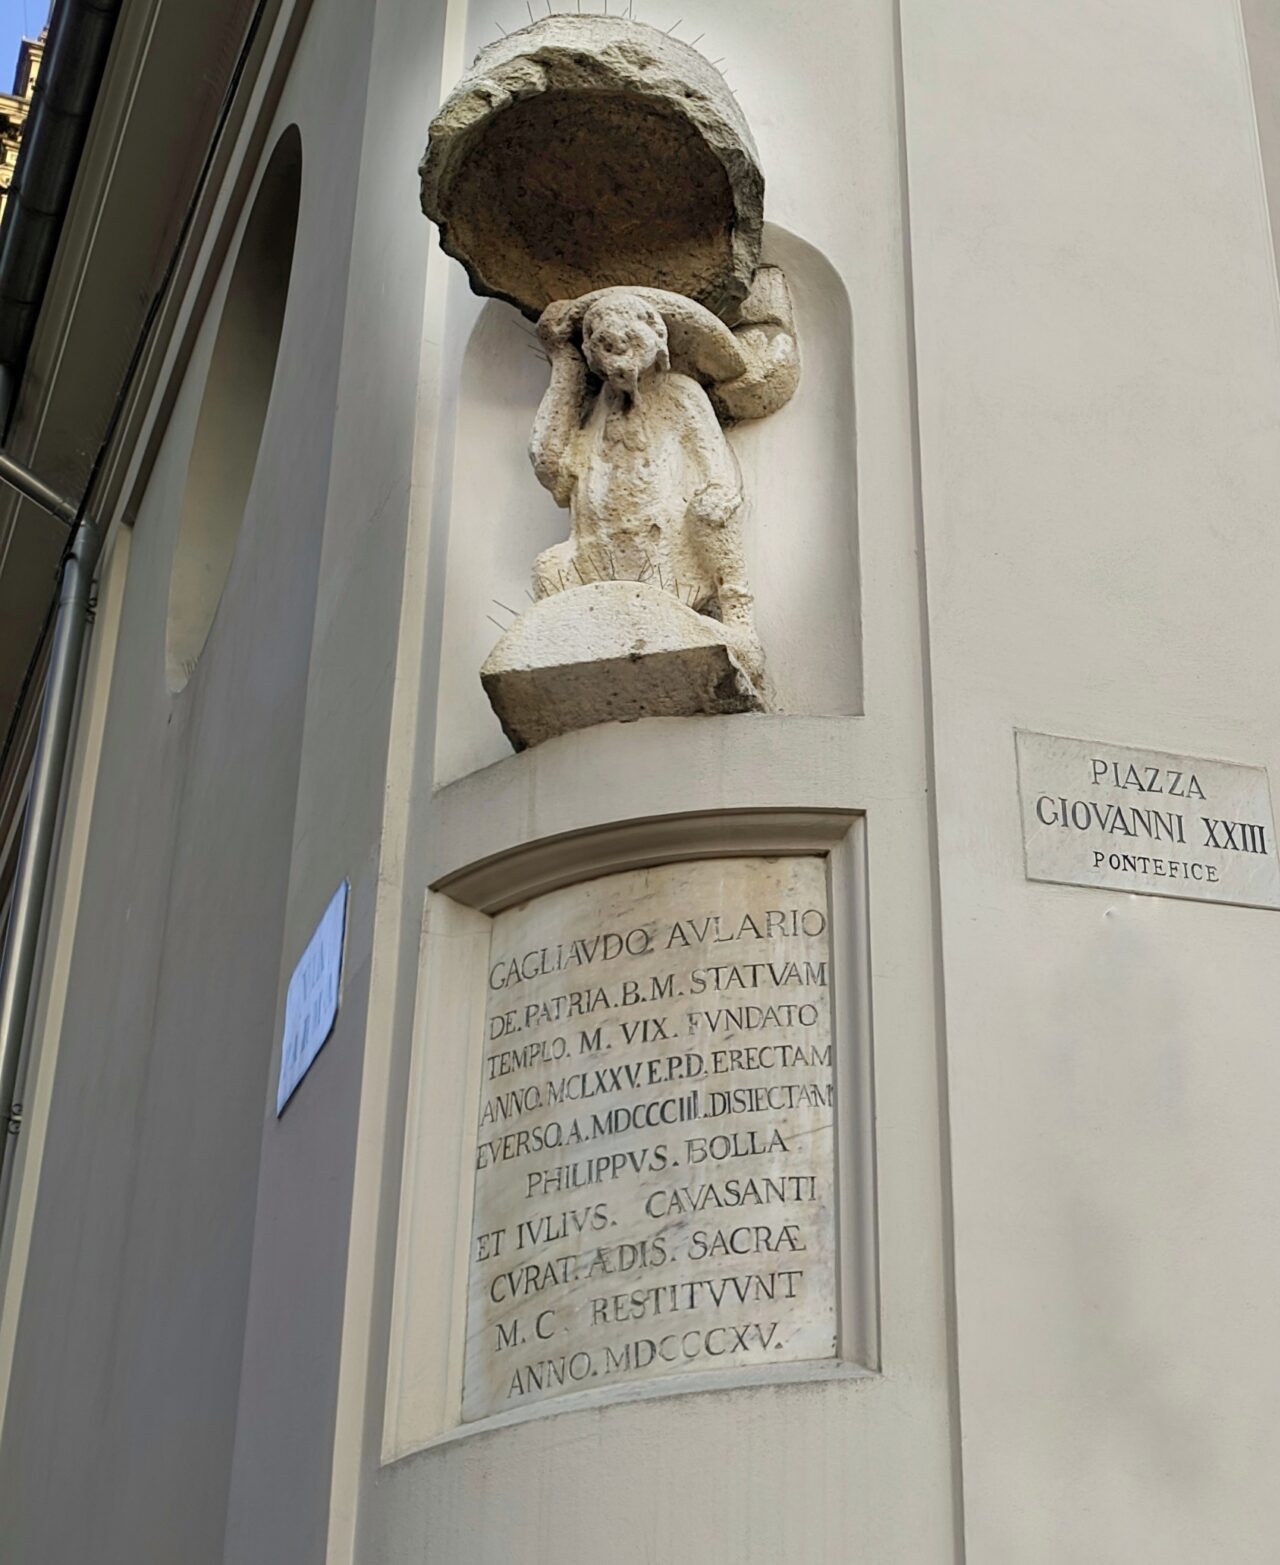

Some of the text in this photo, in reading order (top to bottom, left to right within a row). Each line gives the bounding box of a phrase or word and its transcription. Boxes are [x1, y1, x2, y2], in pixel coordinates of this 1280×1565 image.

[1091, 758, 1206, 800] PIAZZA
[1036, 795, 1268, 854] GIOVANNI XXIII
[1092, 851, 1220, 882] PONTEFICE
[666, 909, 827, 949] AVLARIO
[690, 961, 827, 994] STATVAM
[687, 1003, 818, 1036] FVNDATO
[684, 1128, 790, 1164] BOLLA
[476, 1229, 506, 1262] ET
[645, 1175, 817, 1218] CAVASANTI
[590, 1271, 803, 1328] RESTITVVNT
